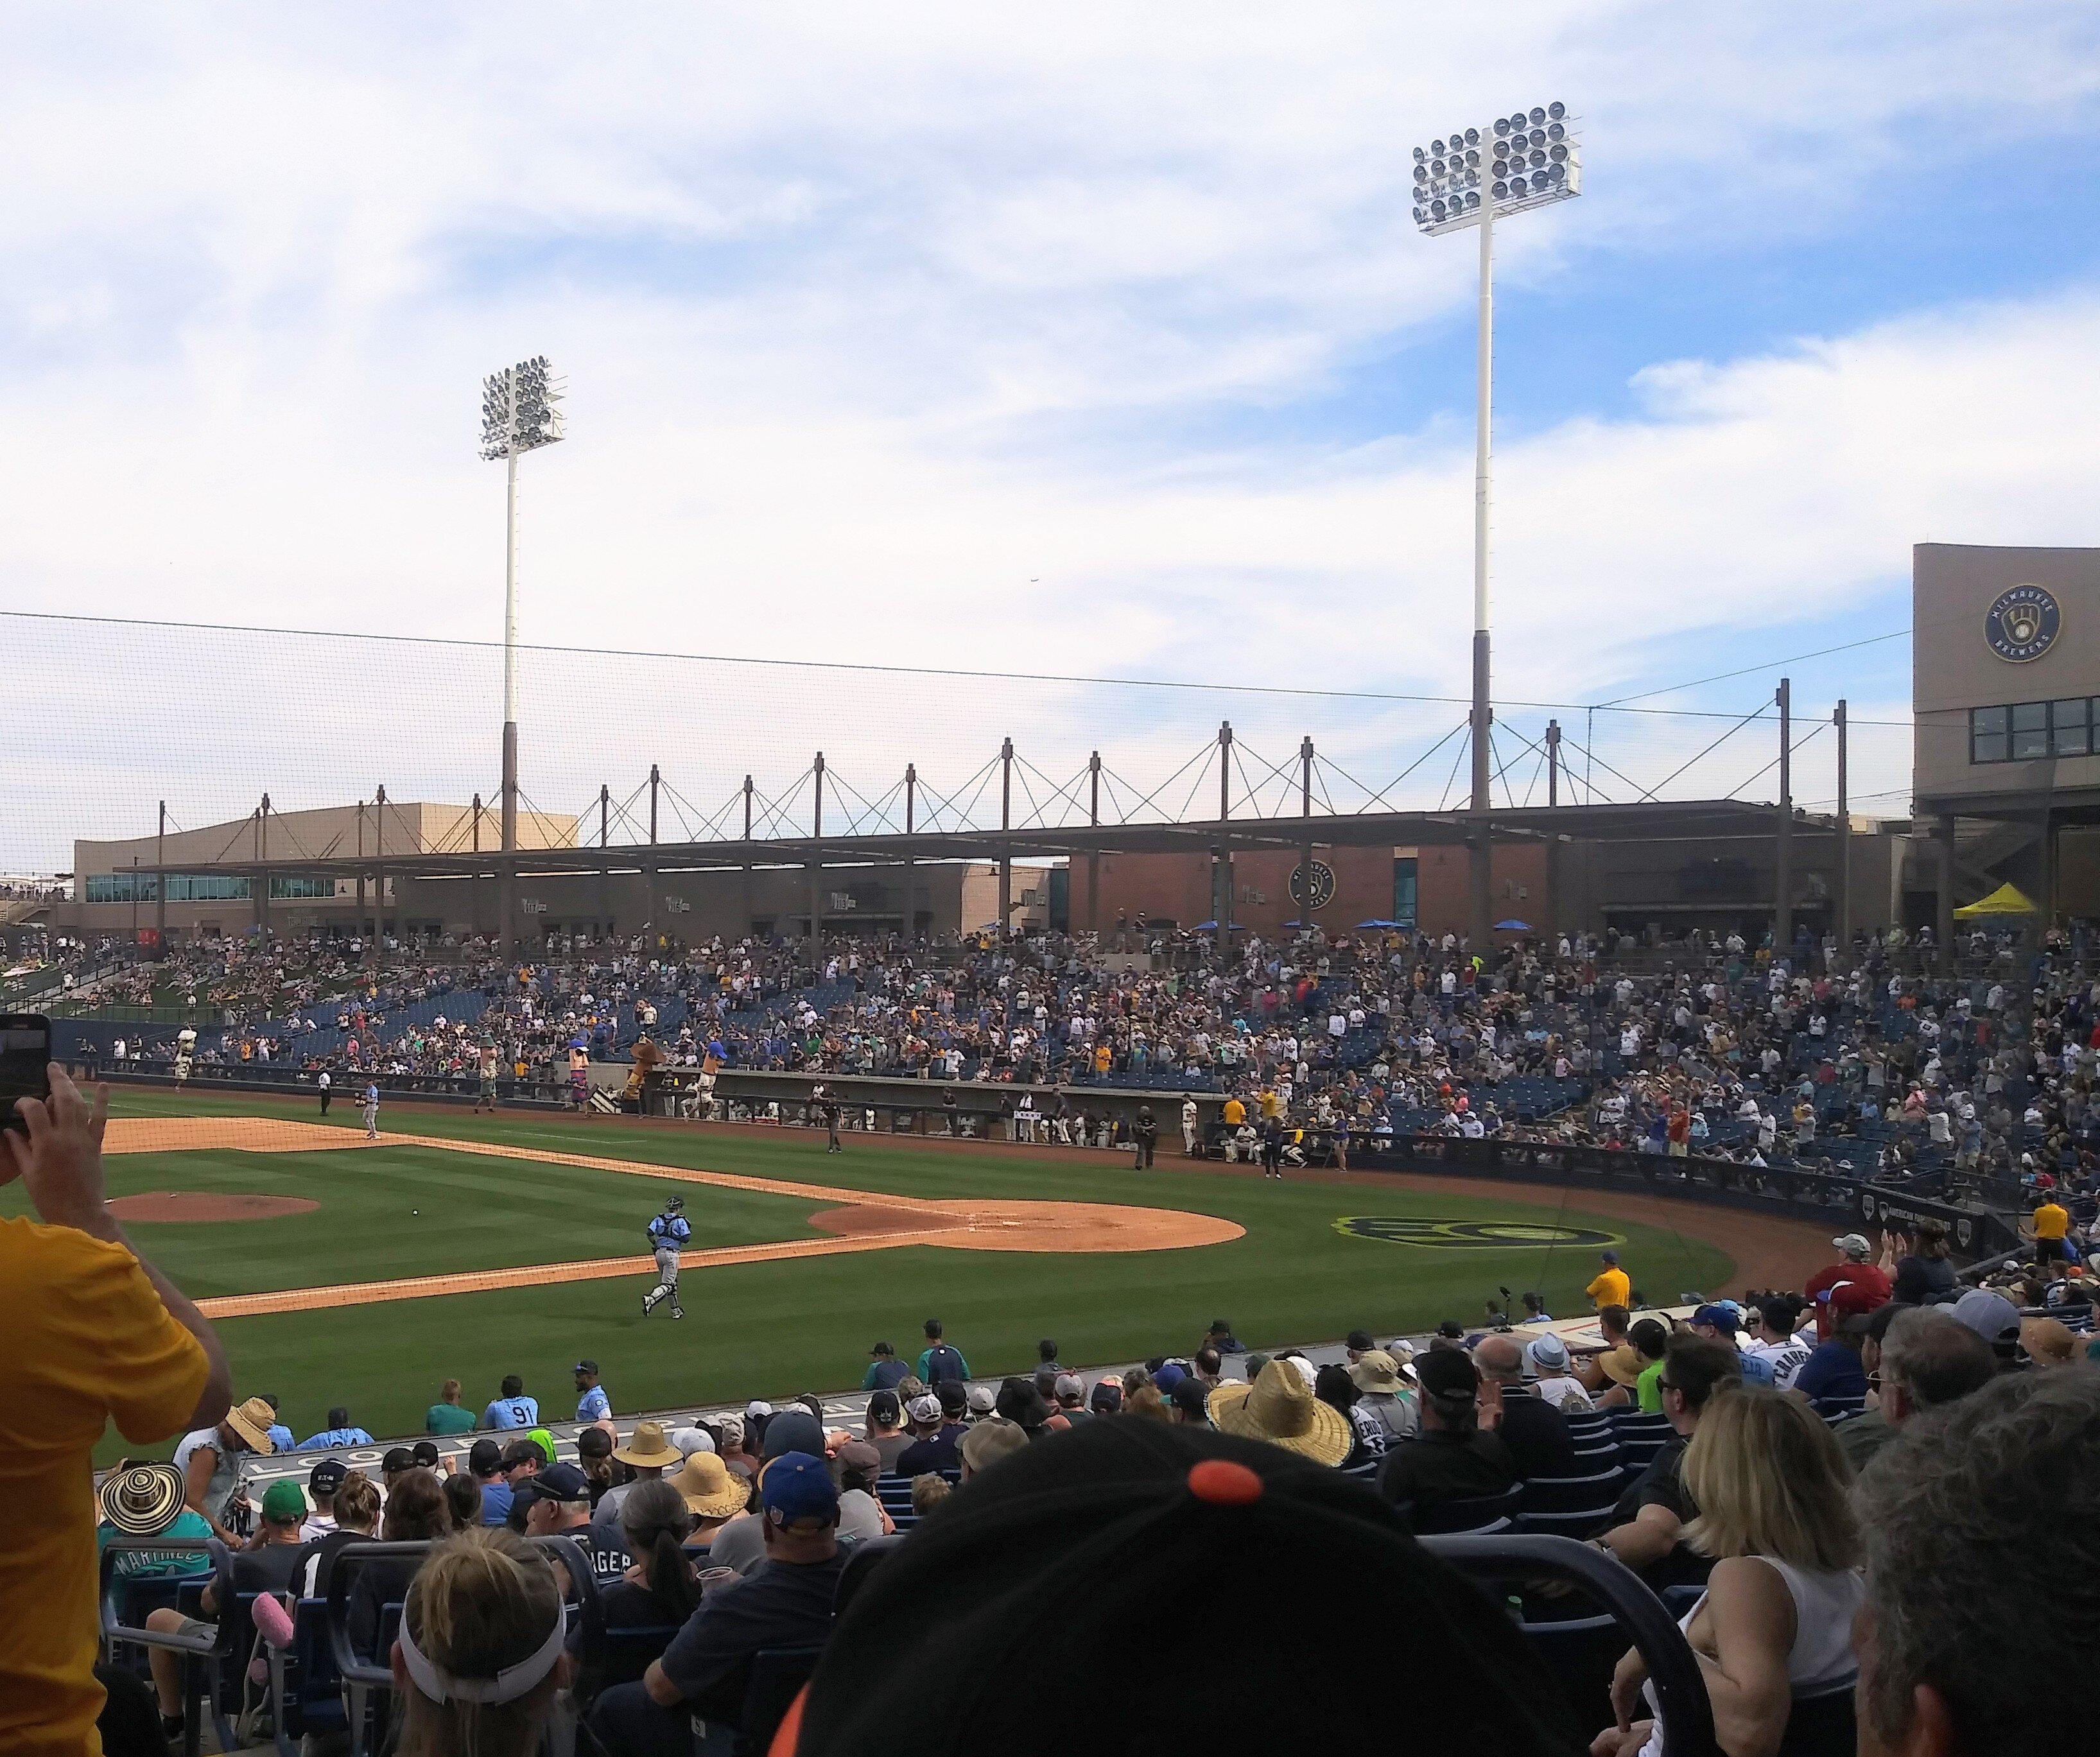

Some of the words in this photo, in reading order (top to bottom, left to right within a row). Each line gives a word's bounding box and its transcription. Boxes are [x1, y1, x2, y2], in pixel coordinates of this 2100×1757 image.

[1991, 590, 2053, 618] MILWAUKEE
[1995, 634, 2049, 656] BREWERS
[512, 1405, 534, 1424] 91
[304, 1552, 322, 1599] 1
